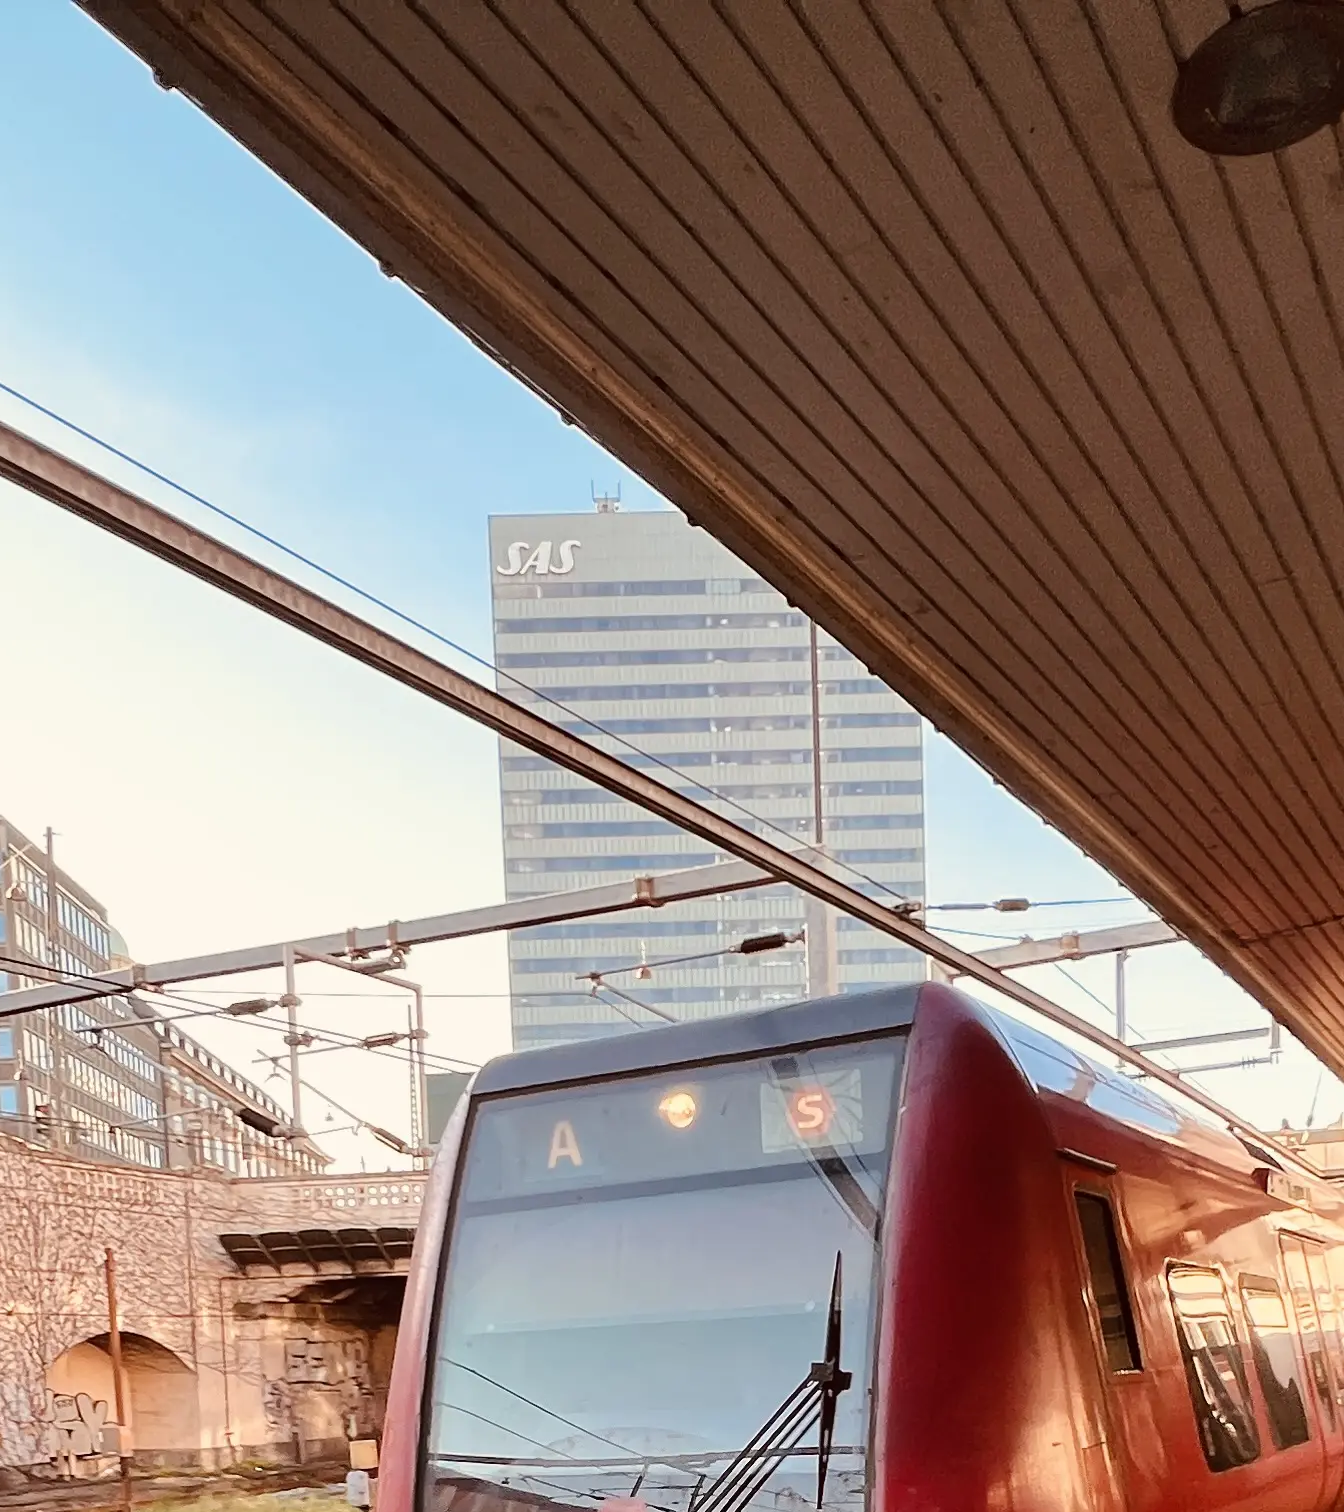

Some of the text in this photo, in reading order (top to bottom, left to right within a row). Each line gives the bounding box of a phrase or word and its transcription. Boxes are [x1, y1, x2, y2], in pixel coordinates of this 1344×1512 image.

[496, 539, 582, 576] SAS
[797, 1093, 824, 1130] S
[547, 1119, 584, 1170] A
